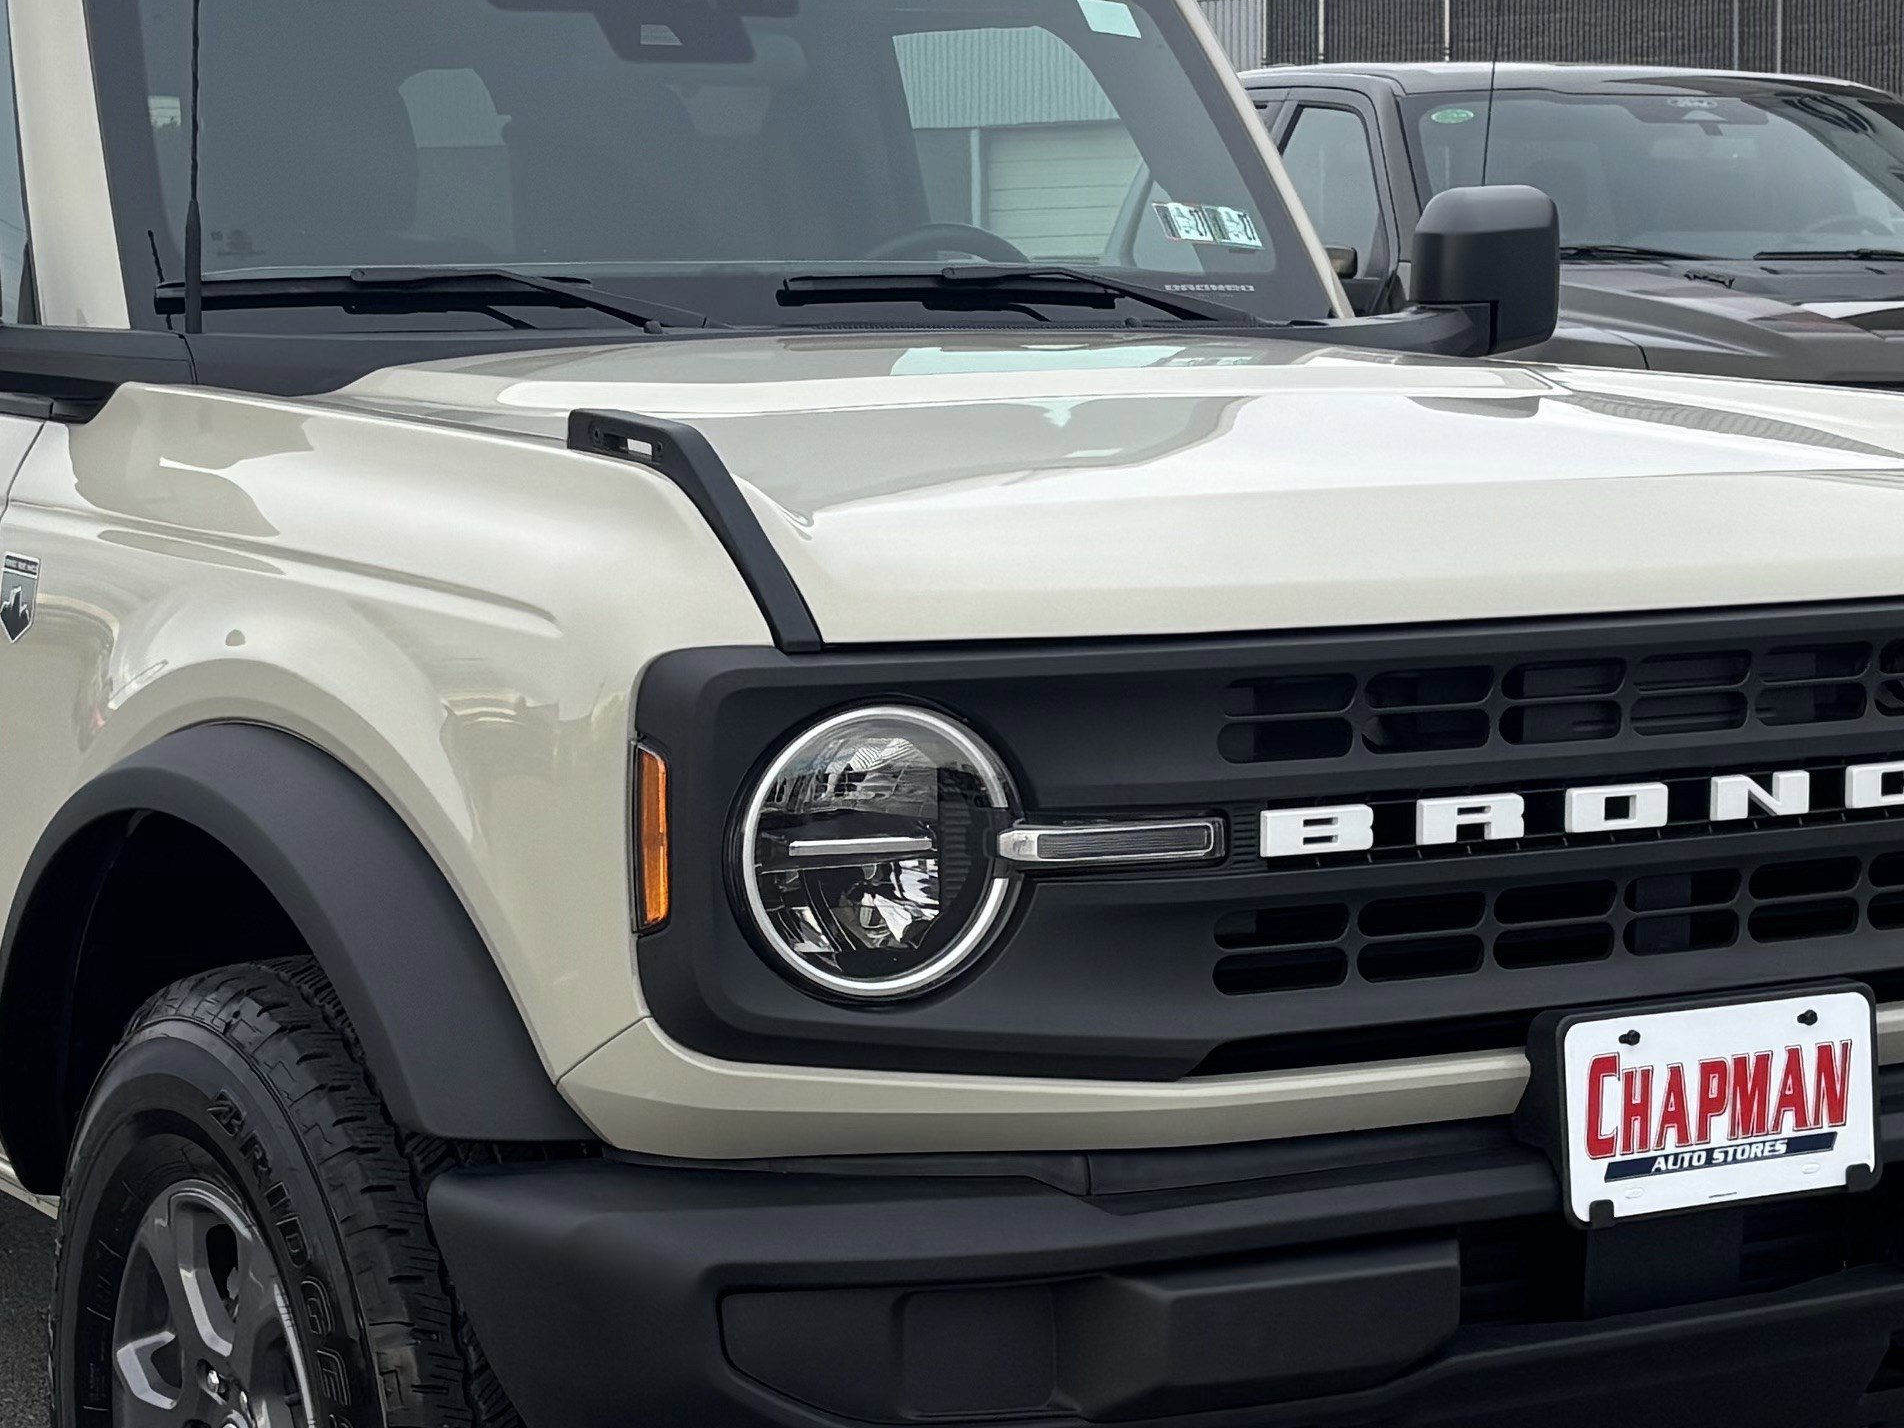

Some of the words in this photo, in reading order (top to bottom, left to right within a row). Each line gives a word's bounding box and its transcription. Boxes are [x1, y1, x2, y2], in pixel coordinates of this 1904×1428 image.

[1585, 1039, 1852, 1160] CHAPMAN
[1650, 1153, 1707, 1173] AUTO
[1711, 1139, 1788, 1164] STORES
